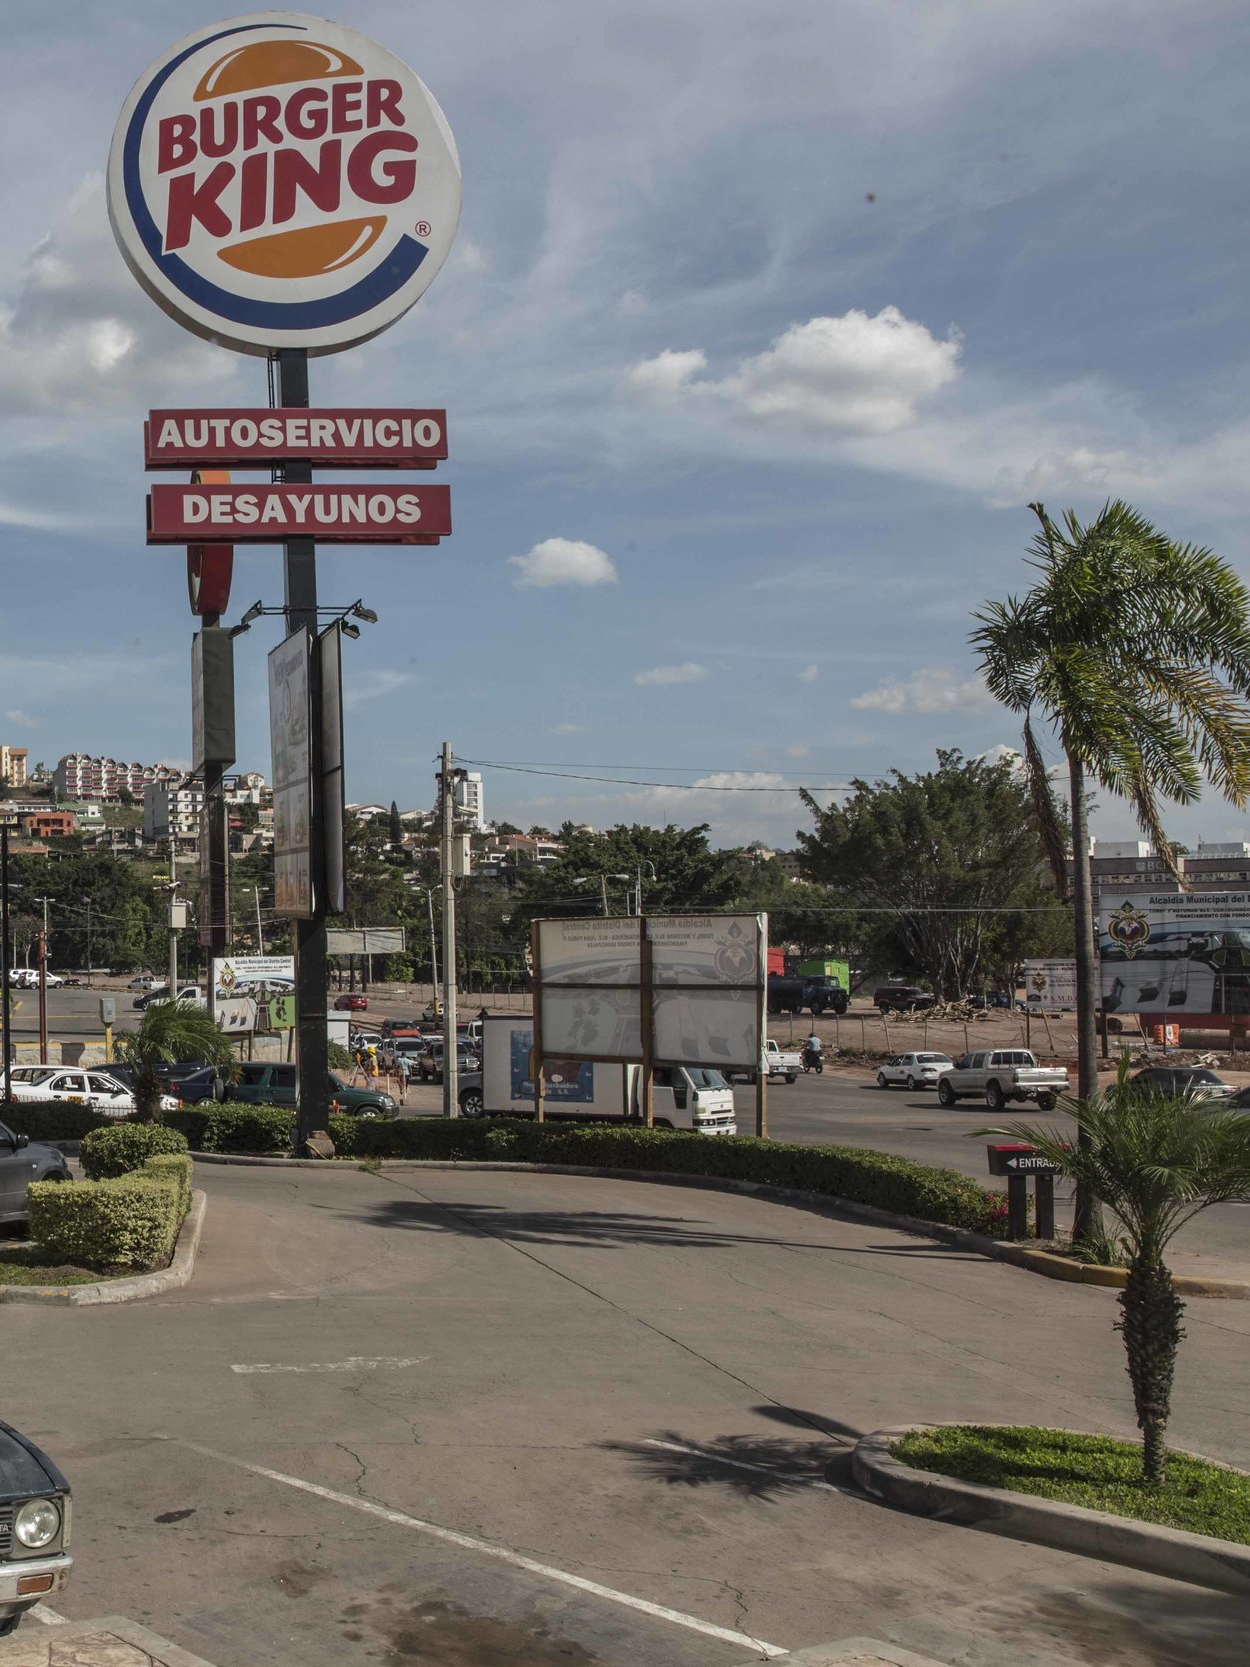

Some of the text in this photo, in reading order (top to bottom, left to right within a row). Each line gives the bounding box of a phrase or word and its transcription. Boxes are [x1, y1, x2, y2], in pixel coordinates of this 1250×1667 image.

[158, 78, 406, 174] BURGER
[165, 130, 418, 252] KING
[157, 418, 441, 448] AUTOSERVICIO
[183, 494, 421, 524] DESAYUNOS
[1186, 895, 1229, 905] Municipal
[1231, 895, 1245, 903] del
